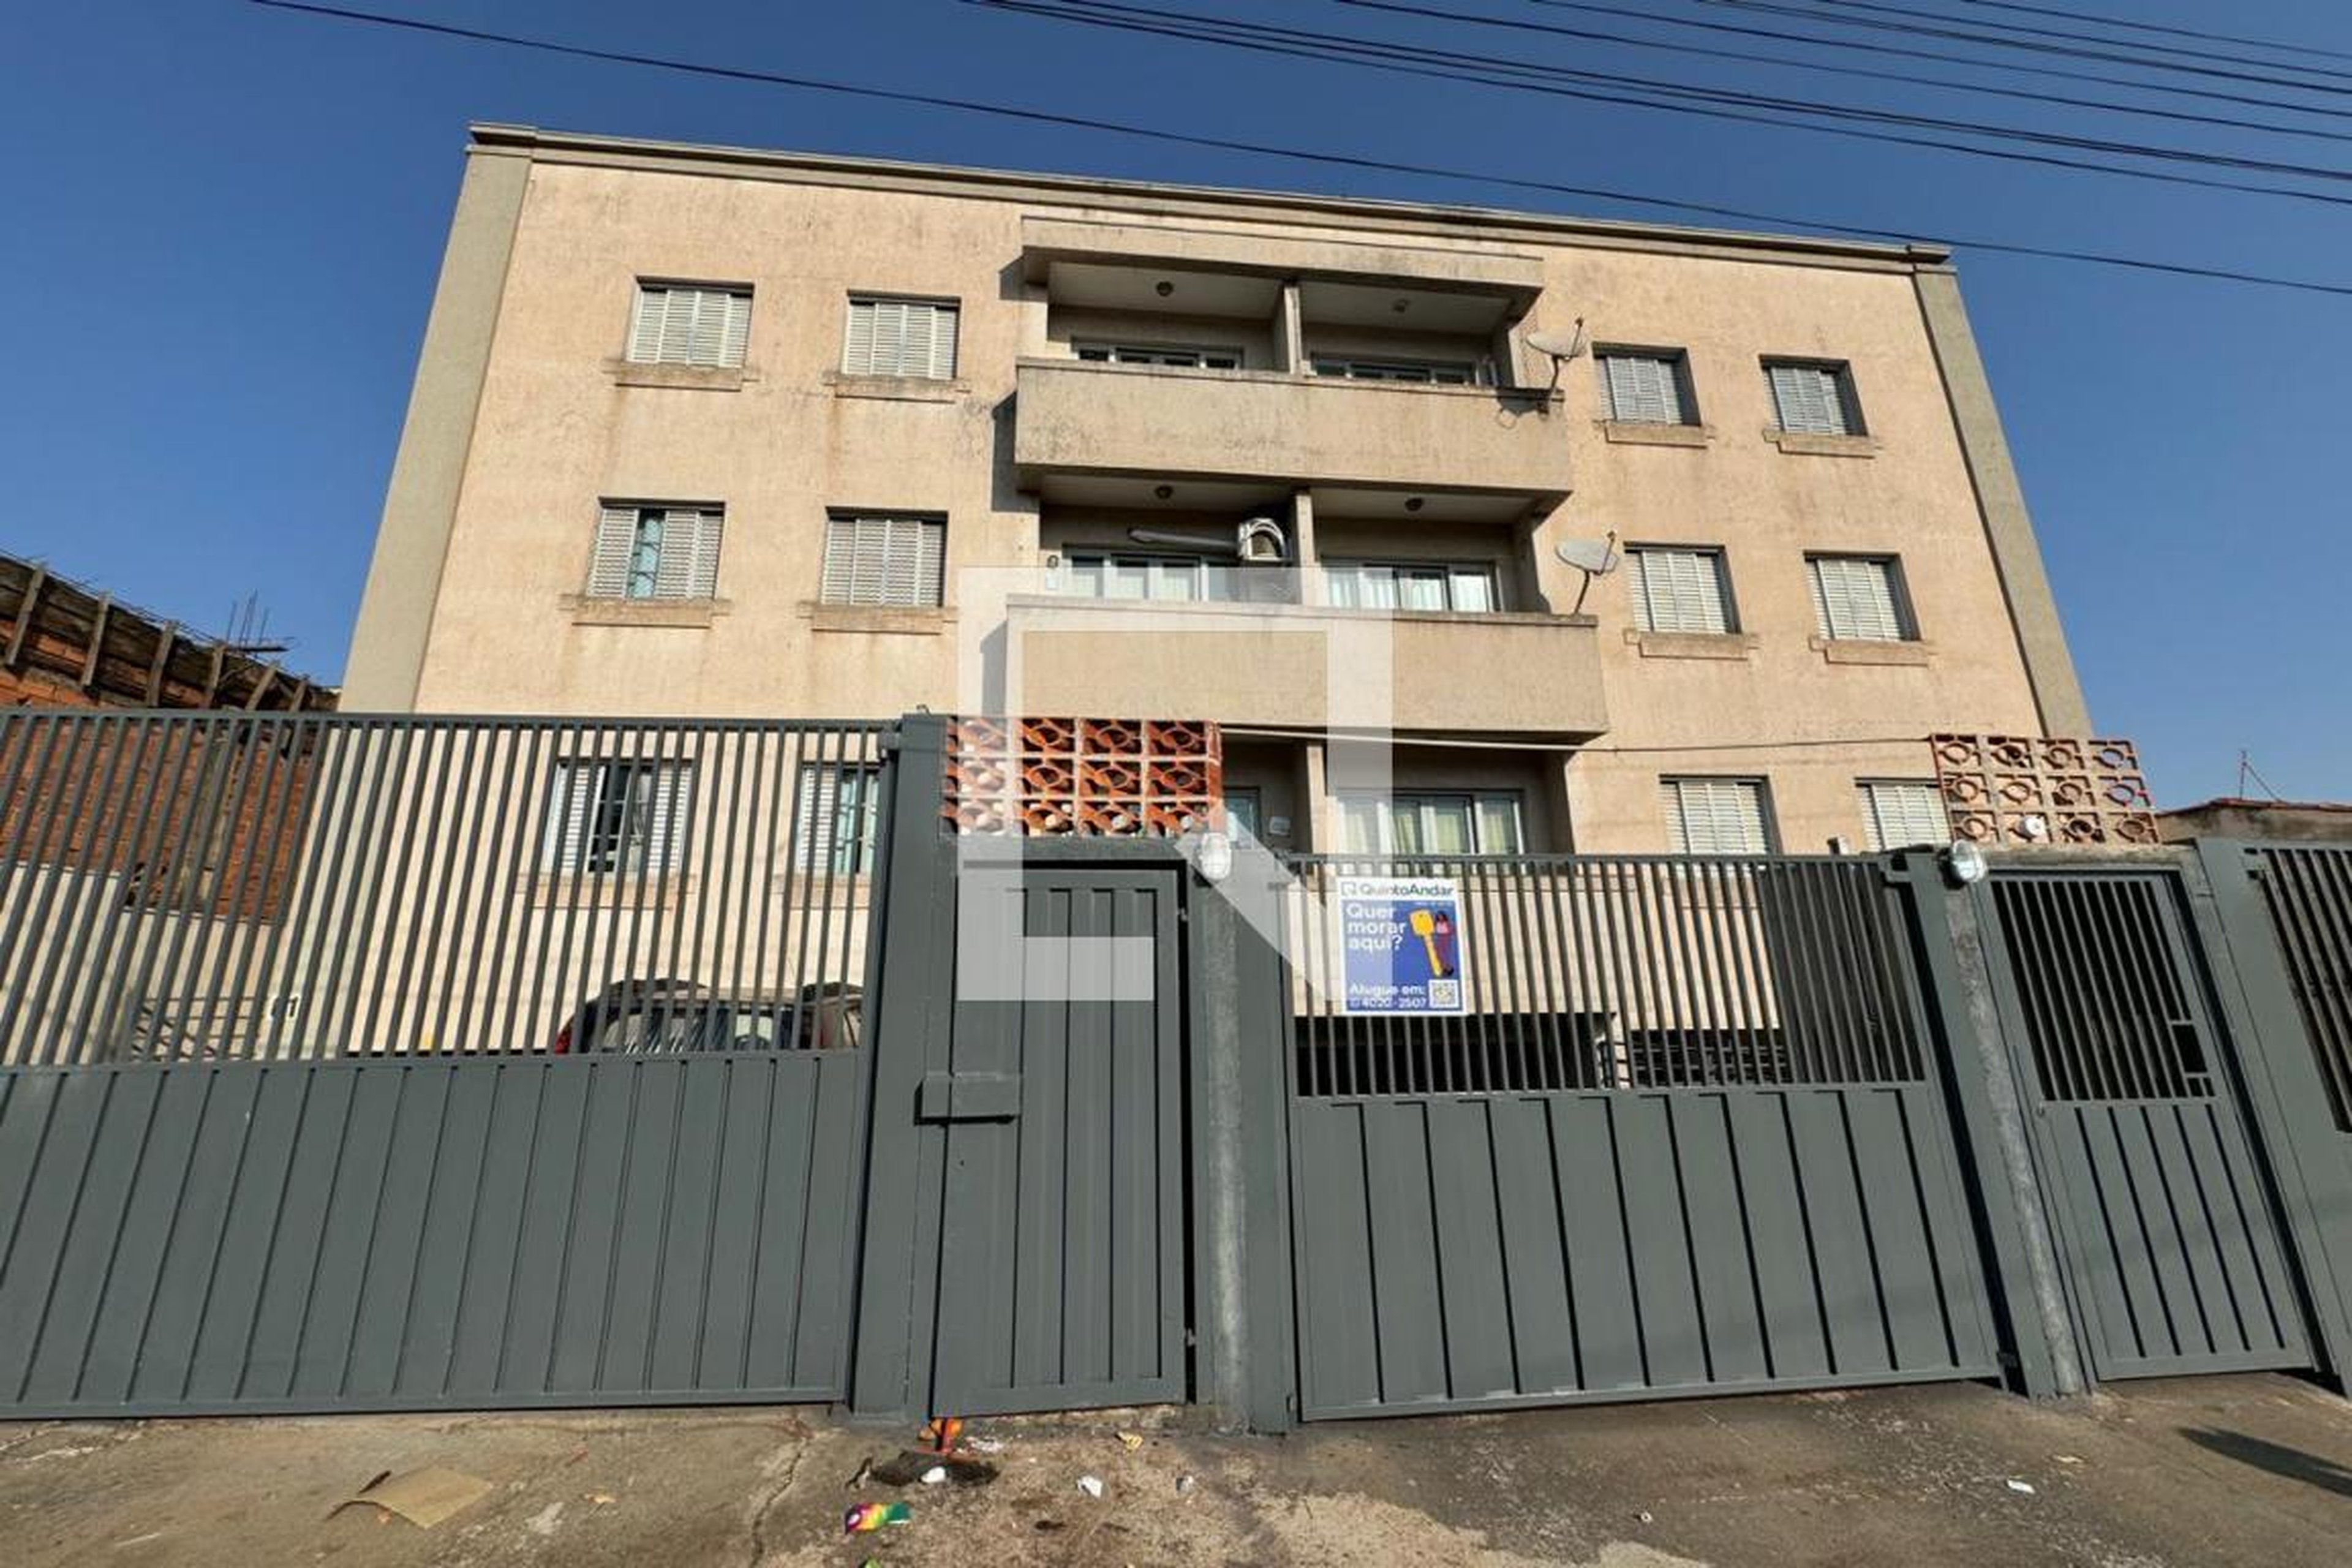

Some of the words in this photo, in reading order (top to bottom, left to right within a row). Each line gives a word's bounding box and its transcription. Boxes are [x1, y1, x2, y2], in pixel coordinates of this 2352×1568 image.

[1359, 883, 1453, 896] QuintoAndar
[1348, 903, 1395, 919] Quer
[1348, 922, 1406, 934] morar
[1349, 935, 1403, 952] aqui?
[1349, 982, 1398, 997] Alugue
